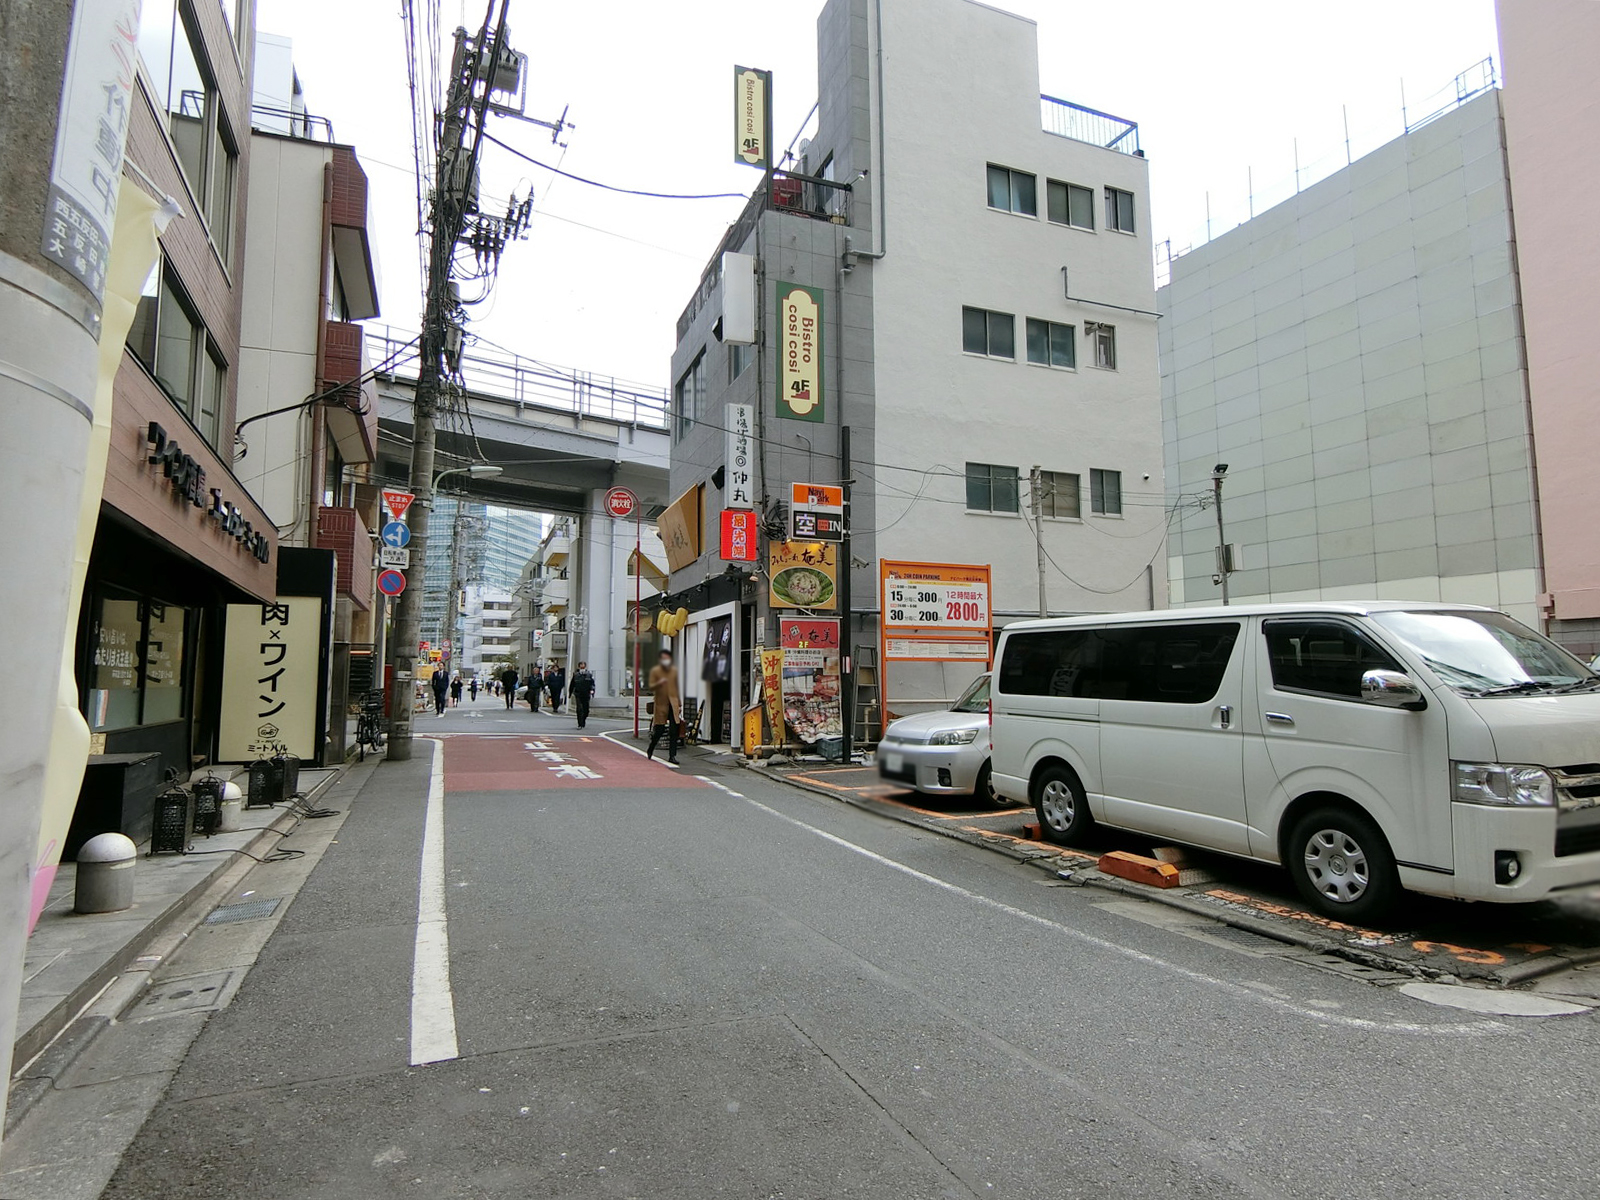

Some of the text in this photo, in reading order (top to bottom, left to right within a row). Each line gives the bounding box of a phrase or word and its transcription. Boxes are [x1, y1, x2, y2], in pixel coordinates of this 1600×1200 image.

[746, 78, 755, 135] Bistro cosi cosi
[743, 138, 759, 148] 4F
[788, 304, 800, 373] cosi cosi
[802, 317, 814, 363] Bistro
[790, 379, 810, 393] 4F
[732, 471, 748, 502] 仲丸
[808, 487, 825, 497] Navi
[388, 495, 409, 503] 止まれ
[611, 499, 631, 509] 消火栓
[808, 495, 830, 510] Park
[796, 513, 816, 536] 空
[828, 520, 841, 532] IN
[731, 513, 747, 559] 最先端
[946, 590, 983, 600] 12時間最大
[798, 641, 809, 649] 2F
[764, 655, 781, 729] 沖縄そば
